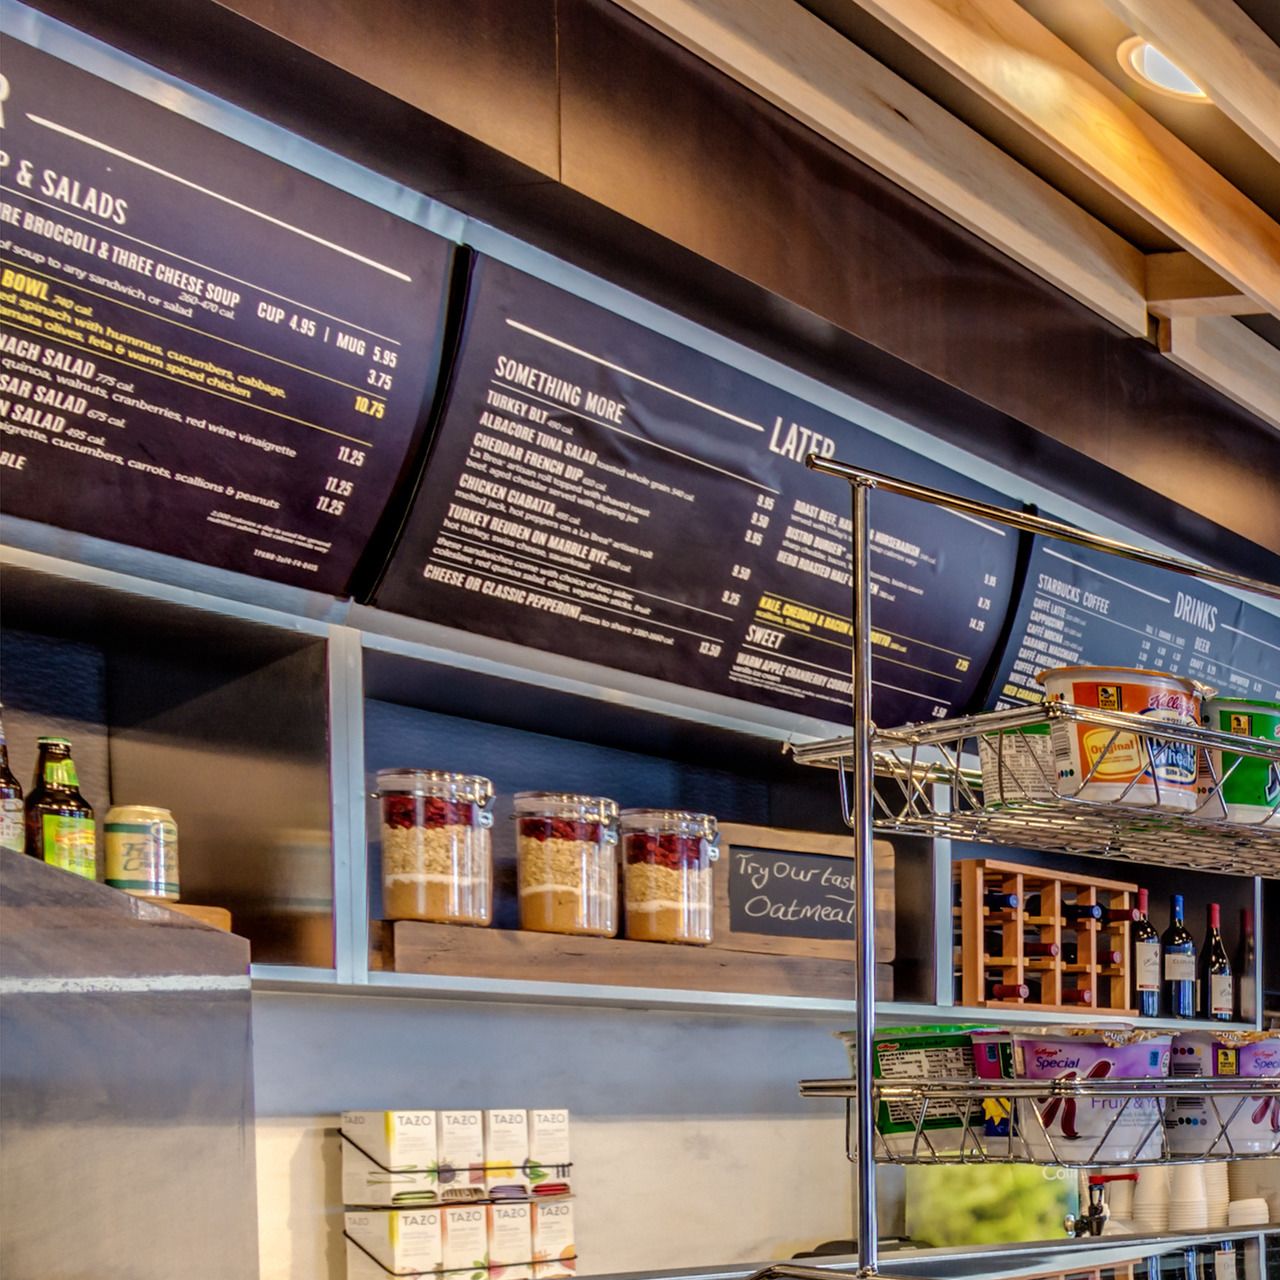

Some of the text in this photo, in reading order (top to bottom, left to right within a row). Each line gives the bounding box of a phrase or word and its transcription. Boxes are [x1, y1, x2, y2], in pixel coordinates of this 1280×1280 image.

[16, 159, 34, 188] &
[41, 169, 128, 225] SALADS
[1, 269, 49, 301] BOWL
[12, 245, 193, 318] soup to any sandwich or salad
[23, 211, 398, 368] BROCCOLI & THREE CHEESE SOUP CUP 4.95 MUG 5.95
[18, 298, 72, 323] spinach
[74, 316, 104, 335] with
[42, 348, 96, 379] SALAD
[87, 334, 252, 398] feta & warm spiced chicken
[367, 369, 393, 391] 3.75
[494, 355, 626, 425] SOMETHING MORE
[33, 385, 88, 415] SALAD
[354, 395, 386, 420] 10.75
[486, 389, 549, 426] TURKEY BLT
[11, 403, 67, 434] SALAD
[185, 415, 206, 430] red
[207, 423, 237, 440] wine
[238, 432, 298, 459] vinaigrette
[479, 411, 536, 446] ALBACORE
[536, 428, 565, 454] TUNA
[563, 442, 598, 466] SALAD
[337, 445, 366, 468] 11.25
[473, 432, 525, 463] CHEDDAR
[524, 449, 565, 475] FRENCH
[564, 465, 585, 482] DIP
[174, 472, 224, 494] scallions
[225, 486, 235, 496] &
[235, 488, 281, 510] peanuts
[325, 476, 354, 497] 11.25
[458, 472, 557, 517] CHICKEN CIABATTA
[316, 495, 346, 516] 11.25
[793, 500, 818, 519] ROAST
[447, 503, 610, 566] TURKEY REUBEN ON MARBLE RYE
[731, 564, 752, 581] 9.50
[423, 564, 582, 620] CHEESE OR CLASSIC PEPPERONI
[721, 590, 742, 606] 9.25
[1038, 574, 1110, 614] STARBUCKS COFFEE
[1174, 592, 1218, 632] DRINKS
[746, 625, 785, 650] SWEET
[1194, 636, 1211, 654] BEER
[736, 652, 764, 669] WARM
[762, 659, 786, 675] APPLE
[785, 665, 827, 687] CRANBERRY
[1091, 740, 1134, 755] Original
[736, 853, 769, 889] Try
[773, 862, 821, 882] Our
[744, 895, 856, 924] Oatmeal
[1104, 1031, 1125, 1044] PULL
[1035, 1056, 1080, 1071] Special
[344, 1116, 365, 1124] TAZO
[397, 1115, 432, 1126] TAZO
[445, 1115, 478, 1126] TAZO
[493, 1114, 523, 1125] TAZO
[536, 1113, 565, 1124] TAZO
[348, 1217, 369, 1226] TAZO
[402, 1214, 437, 1226] TAZO
[450, 1211, 482, 1223] TAZO
[496, 1208, 527, 1219] TAZO
[539, 1206, 569, 1217] TAZO
